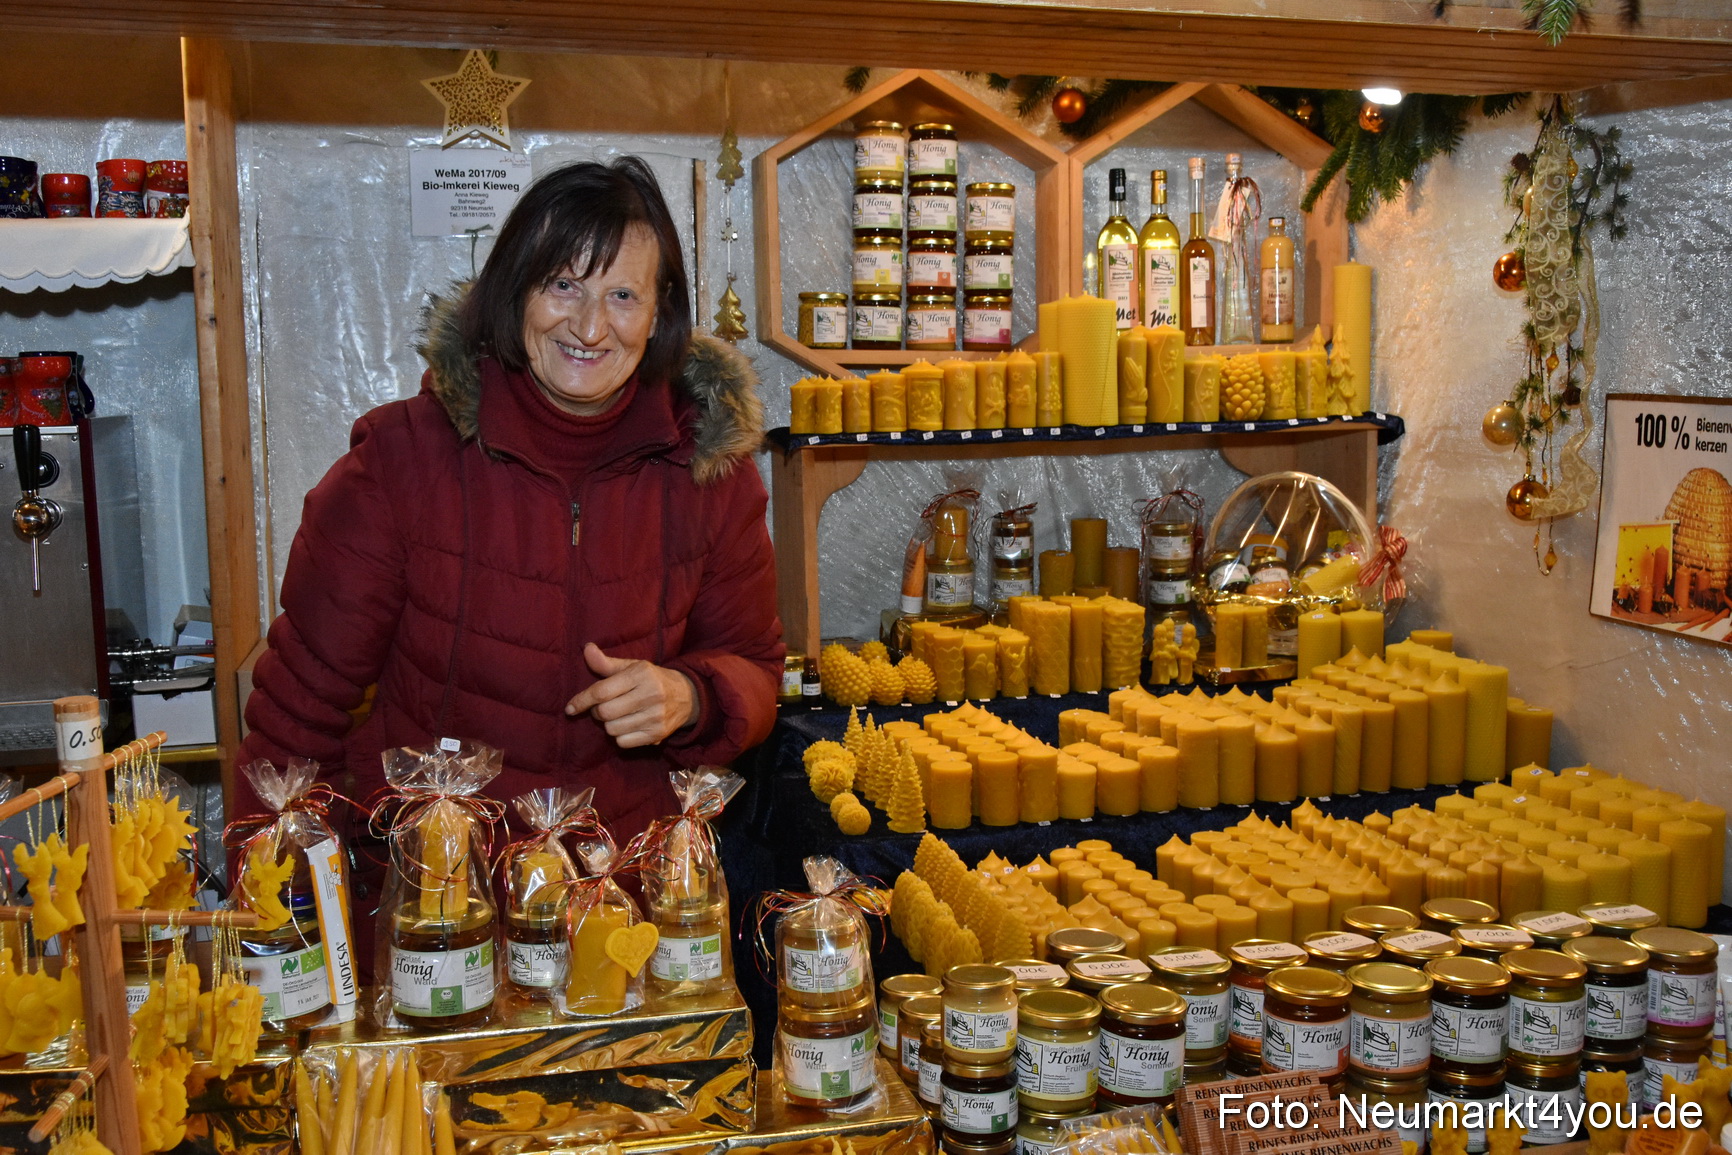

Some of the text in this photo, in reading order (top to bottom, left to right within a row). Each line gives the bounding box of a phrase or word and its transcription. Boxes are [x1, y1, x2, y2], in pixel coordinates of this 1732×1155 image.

[872, 139, 899, 152] Honig
[922, 143, 947, 155] Honig
[434, 169, 507, 178] WeMa 2017/09
[422, 181, 520, 192] Bio-Imkerei Kieweg
[866, 197, 892, 209] Honig
[925, 199, 950, 211] Honig
[990, 201, 1013, 213] Honig
[855, 254, 878, 265] Honig
[916, 256, 941, 269] Honig
[975, 258, 1001, 270] Honig
[877, 310, 899, 322] Honig
[927, 313, 951, 325] Honig
[977, 312, 1002, 325] Honig
[1116, 307, 1136, 321] Met
[1150, 309, 1177, 328] Met
[1635, 413, 1667, 449] 100
[1671, 415, 1690, 450] %
[1695, 436, 1728, 453] kerzen
[1318, 937, 1353, 947] 6,00€
[1245, 944, 1285, 954] 6,00€
[817, 954, 849, 967] Honig
[1163, 953, 1204, 963] 6,00€
[338, 941, 354, 997] LINDESA
[394, 957, 434, 981] Honig
[1016, 967, 1048, 975] ,00€
[1088, 961, 1131, 971] 6,00€
[979, 1017, 1009, 1029] Honig
[1465, 1014, 1505, 1032] Honig
[1301, 1027, 1343, 1045] Honig
[786, 1042, 824, 1066] Honig
[1047, 1049, 1091, 1067] Honig
[1123, 1046, 1170, 1065] Honig
[1140, 1061, 1175, 1070] Sommer
[1195, 1075, 1312, 1100] REINES BIENENWACHS
[962, 1098, 994, 1112] Honig
